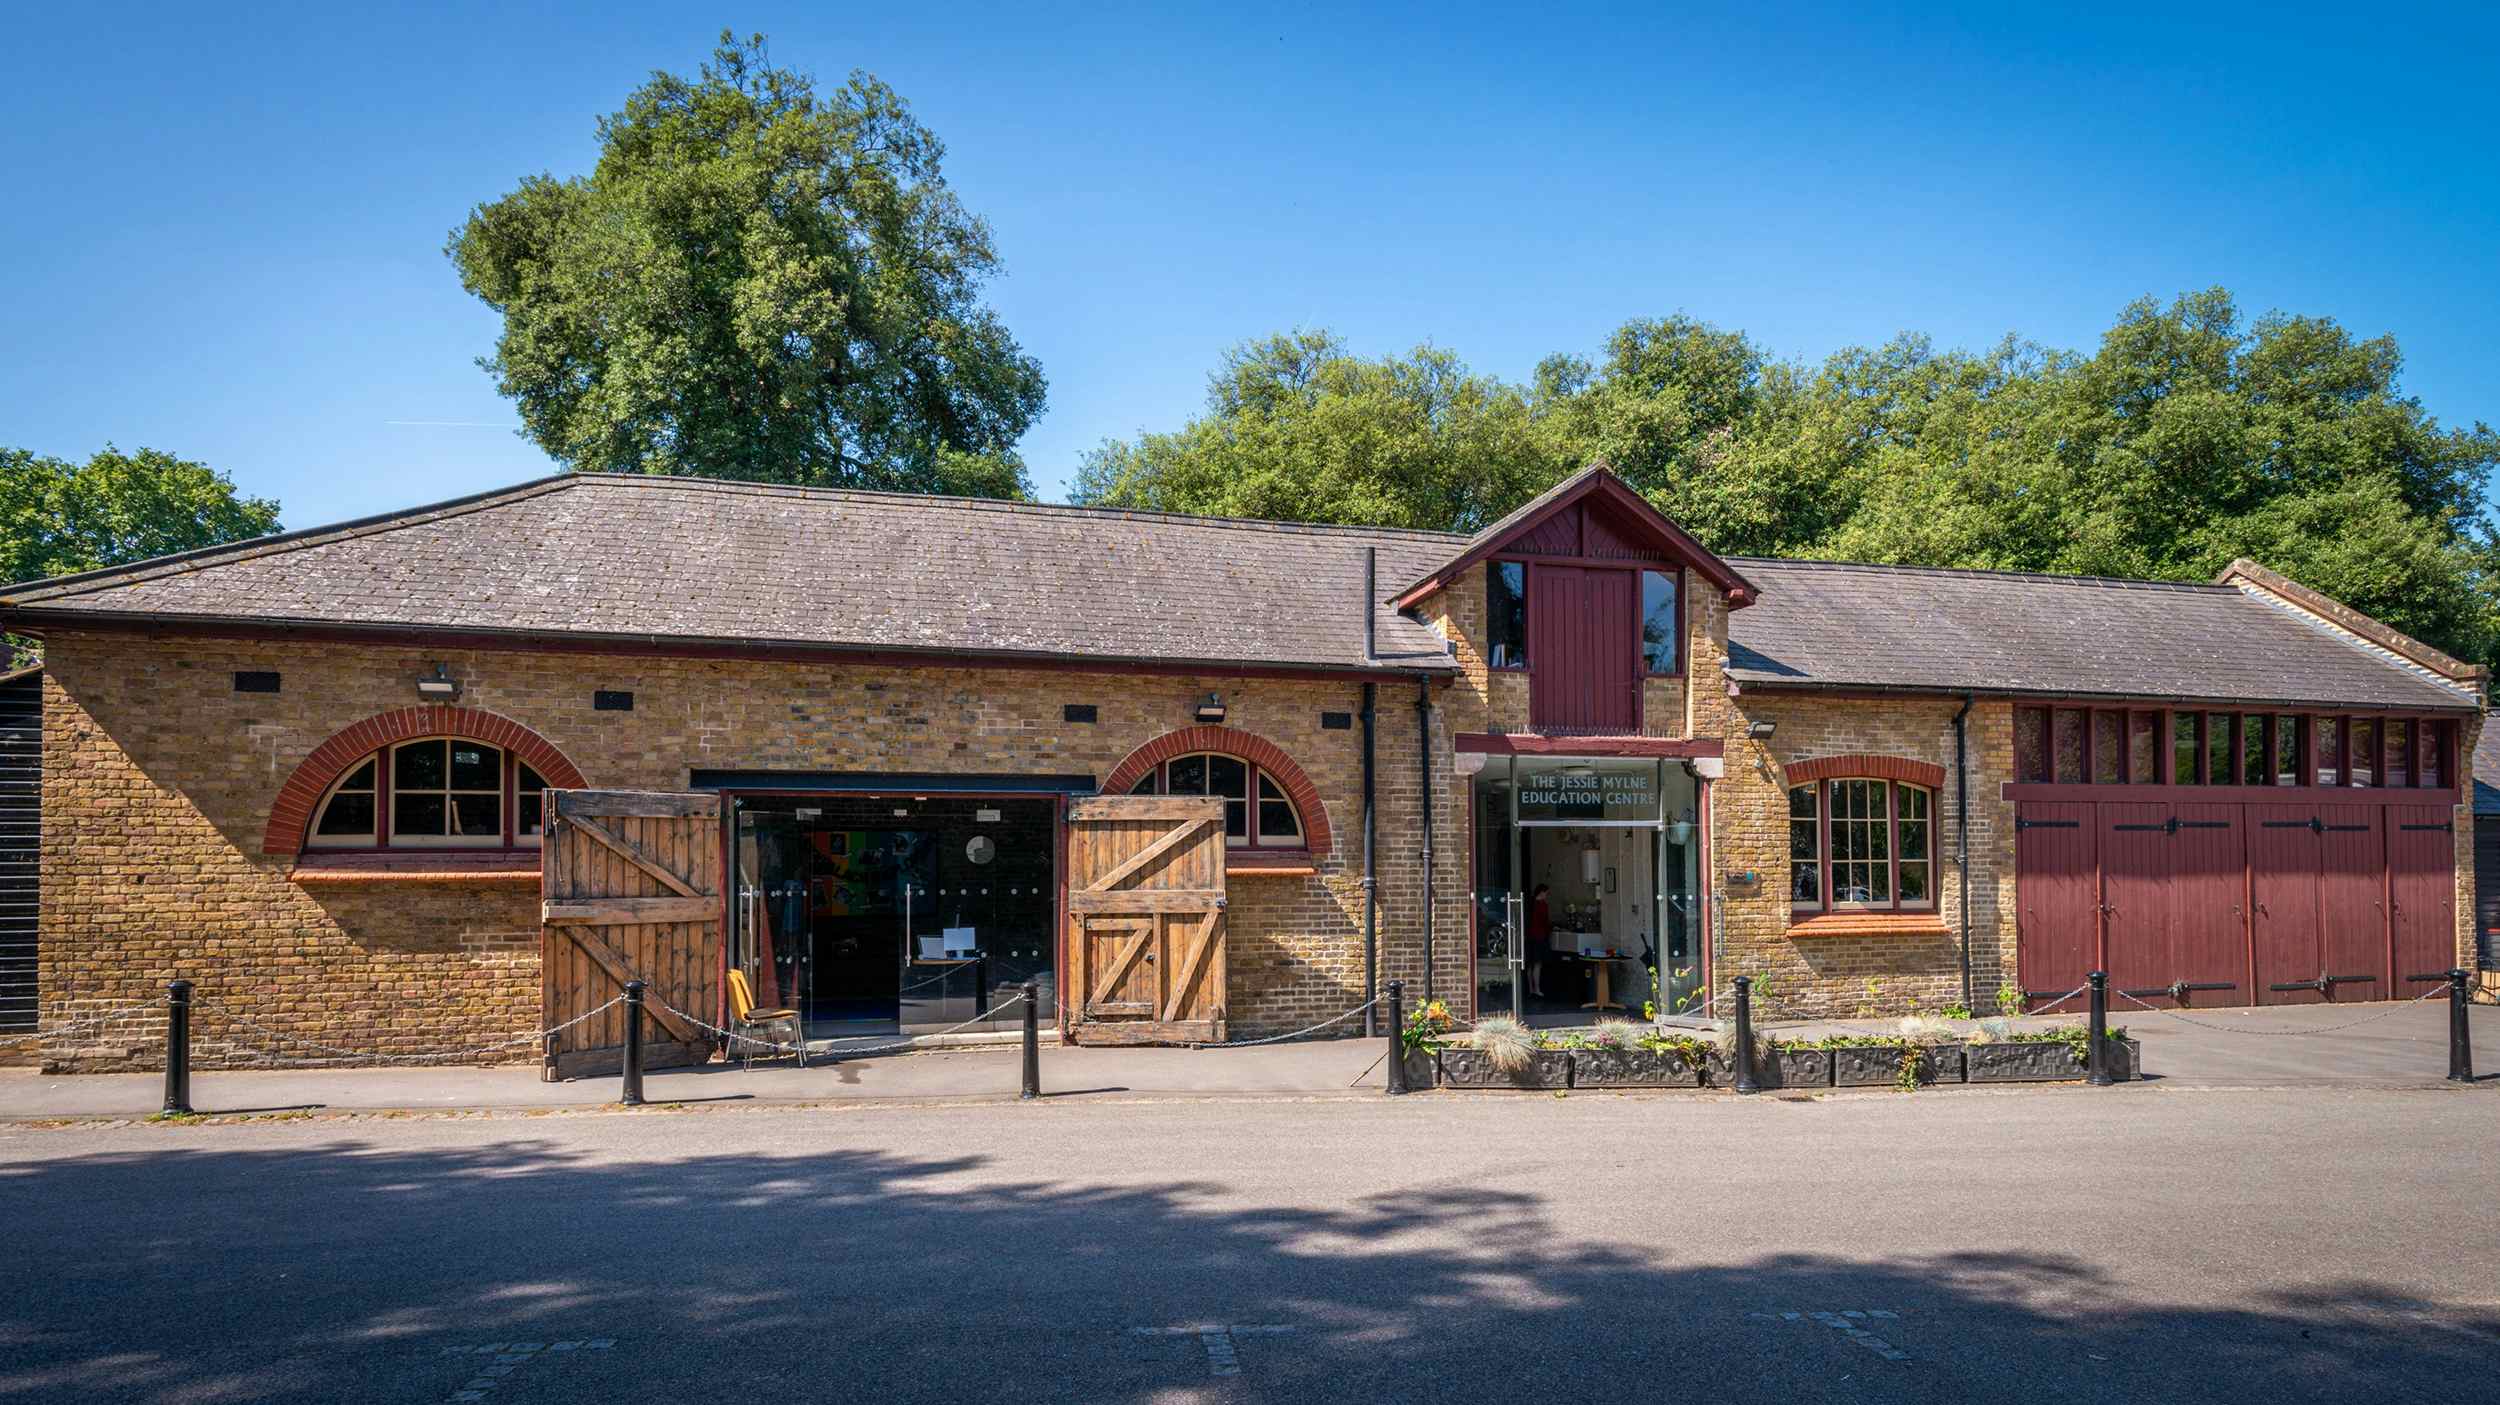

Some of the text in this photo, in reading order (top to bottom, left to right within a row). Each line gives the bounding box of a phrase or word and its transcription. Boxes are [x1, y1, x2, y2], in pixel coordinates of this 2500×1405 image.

[1531, 775, 1648, 790] THE JESSIE MYLNE
[1521, 791, 1656, 804] EDUCATION CENTRE
